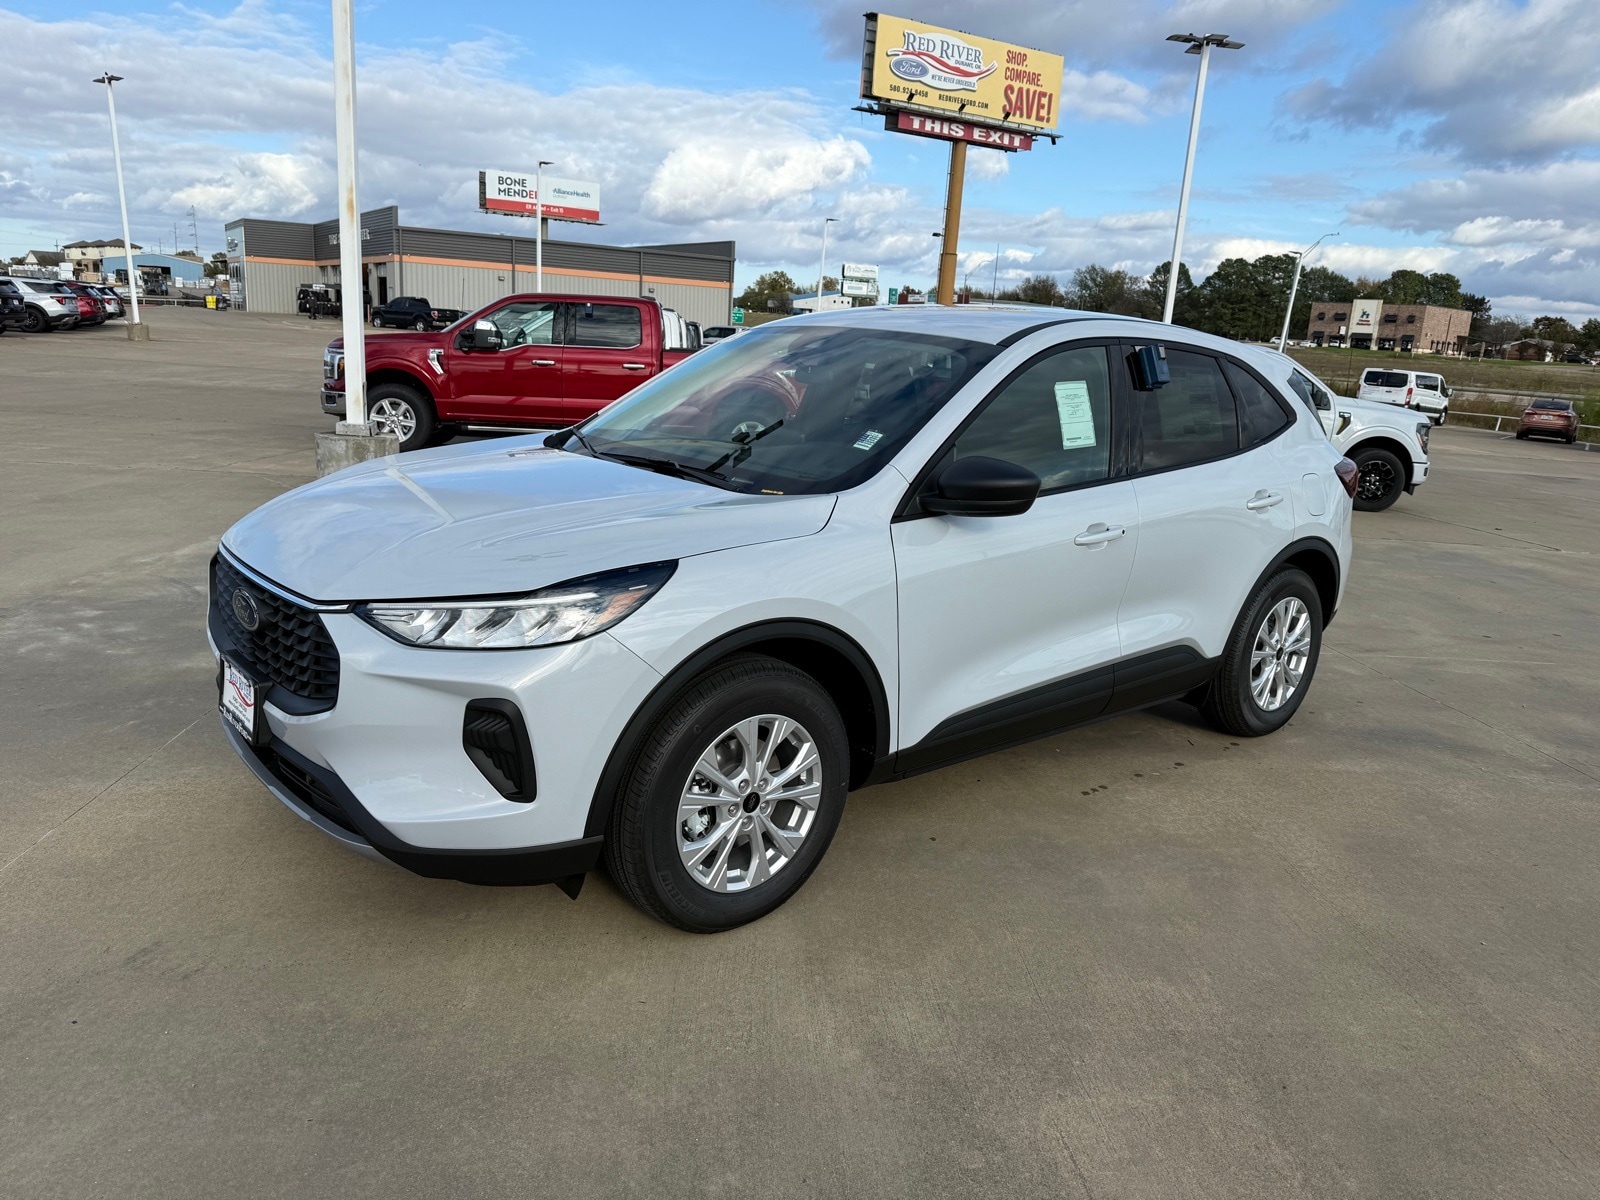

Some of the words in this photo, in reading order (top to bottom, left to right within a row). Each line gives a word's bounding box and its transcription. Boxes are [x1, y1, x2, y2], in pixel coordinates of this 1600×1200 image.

[905, 31, 936, 53] RED
[940, 40, 982, 63] RIVER
[900, 60, 921, 74] Ford
[1006, 50, 1028, 67] SHOP.
[1004, 66, 1043, 88] COMPARE.
[1002, 84, 1053, 123] SAVE!
[909, 115, 964, 137] THIS
[972, 126, 1024, 147] EXIT
[498, 176, 527, 188] BONE
